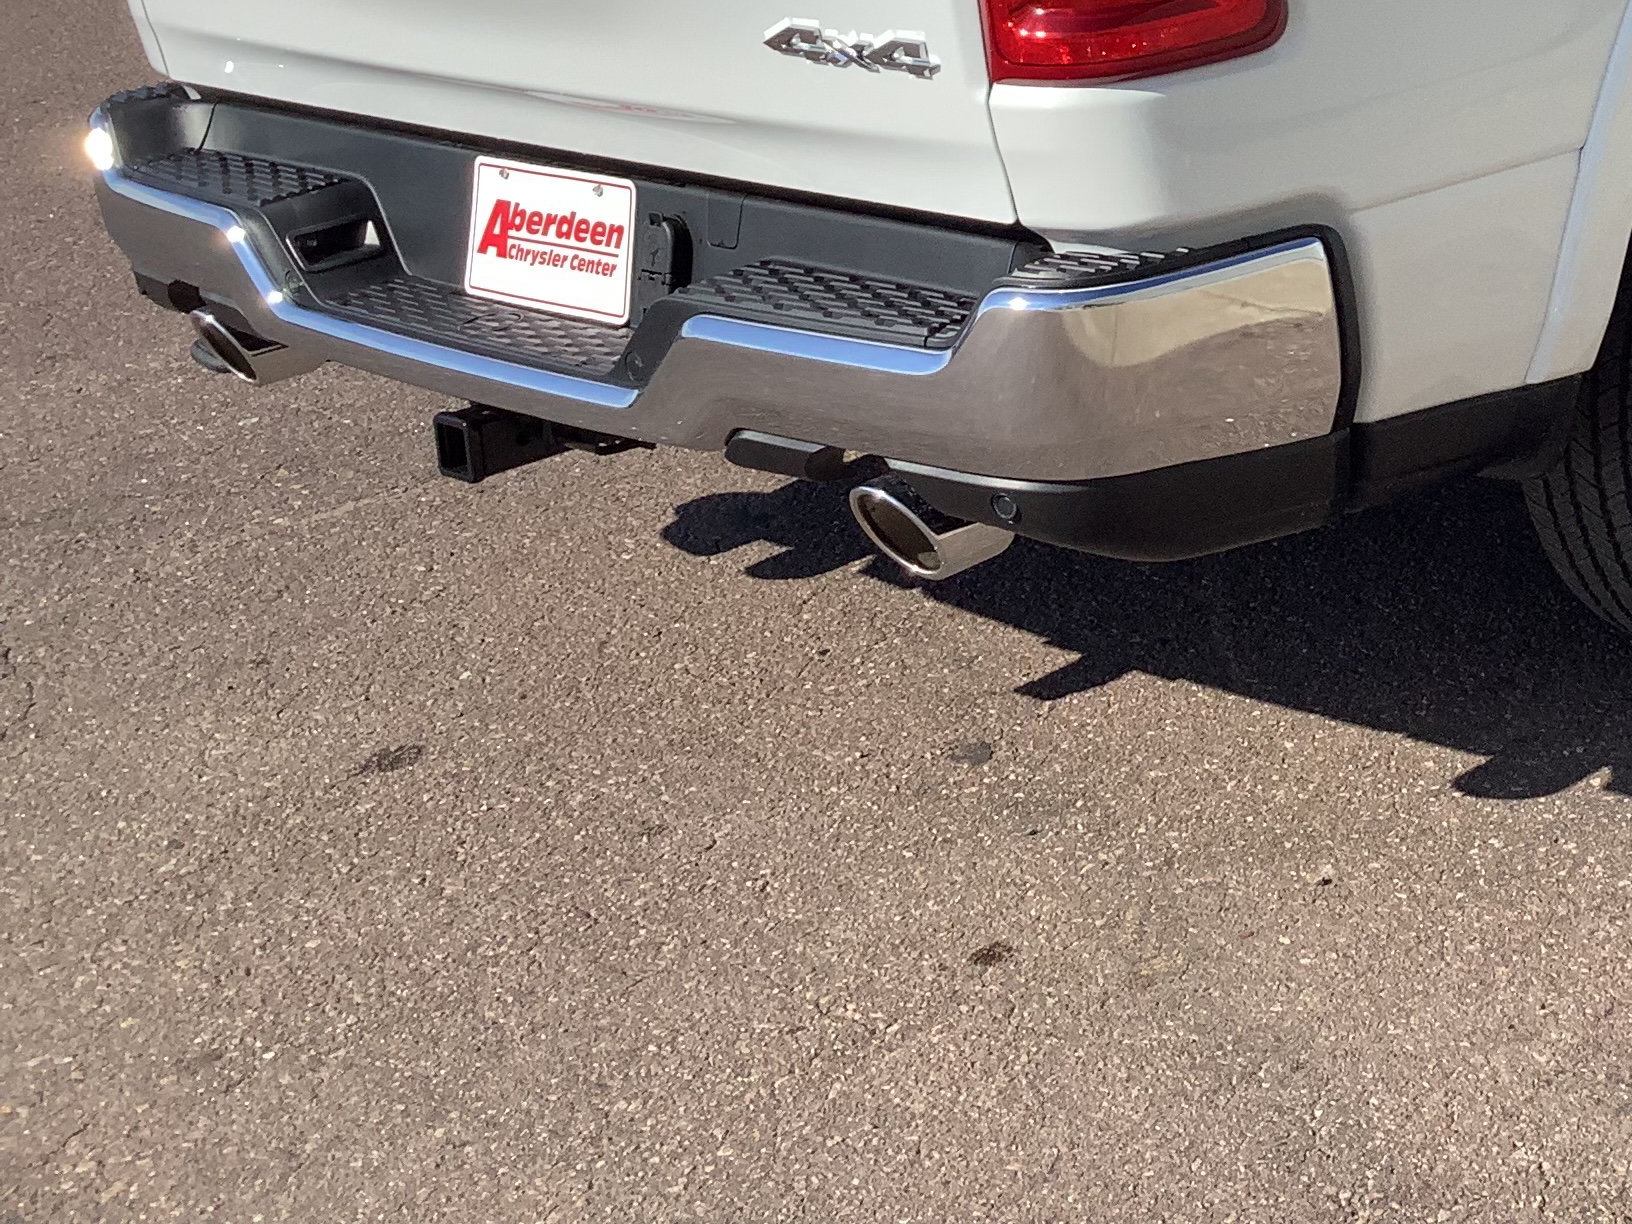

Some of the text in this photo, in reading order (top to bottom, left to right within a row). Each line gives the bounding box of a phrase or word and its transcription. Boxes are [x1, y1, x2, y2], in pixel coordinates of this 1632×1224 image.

[477, 198, 625, 258] Aberdeen
[507, 243, 618, 278] Chrysler Center
